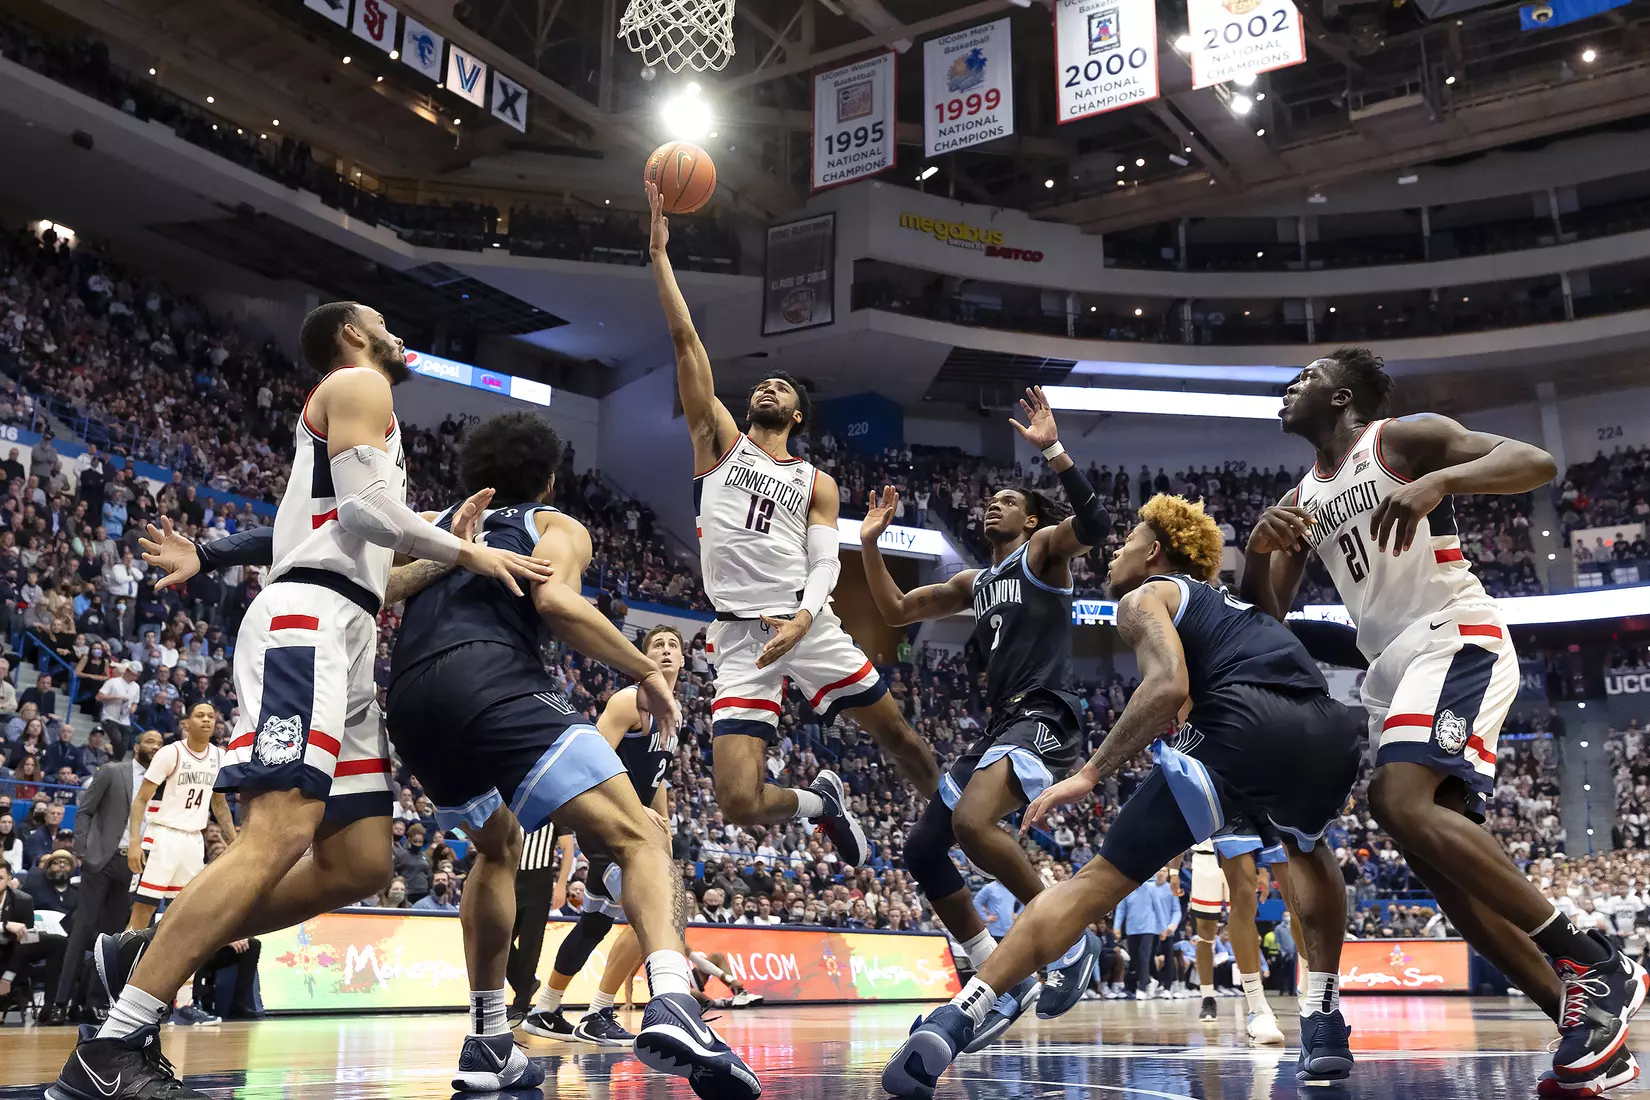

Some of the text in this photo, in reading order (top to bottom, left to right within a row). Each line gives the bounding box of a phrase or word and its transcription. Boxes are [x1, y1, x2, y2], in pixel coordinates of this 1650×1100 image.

[938, 24, 995, 46] UConn Men's
[1203, 9, 1290, 51] 2002
[943, 36, 990, 54] Basketball
[1212, 40, 1283, 63] NATIONAL
[850, 56, 888, 73] Women's
[1065, 47, 1148, 88] 2000
[1207, 51, 1291, 79] CHAMPIONS
[833, 69, 877, 88] Basketball
[1074, 76, 1140, 100] NATIONAL
[498, 79, 523, 123] X
[935, 87, 1001, 124] 1999
[1069, 87, 1146, 115] CHAMPIONS
[824, 120, 884, 155] 1995
[934, 125, 1004, 152] CHAMPIONS
[939, 115, 999, 138] NATIONAL
[822, 158, 887, 183] CHAMPIONS
[827, 147, 882, 169] NATIONAL
[899, 211, 1005, 246] megabus
[771, 276, 795, 291] CLASS
[422, 359, 461, 378] pepsi
[847, 421, 869, 437] 220
[1597, 425, 1624, 441] 224
[724, 465, 805, 516] CONNECTICUT
[744, 494, 776, 535] 12
[1338, 525, 1370, 584] 21
[650, 757, 667, 788] 2
[184, 788, 204, 810] 24
